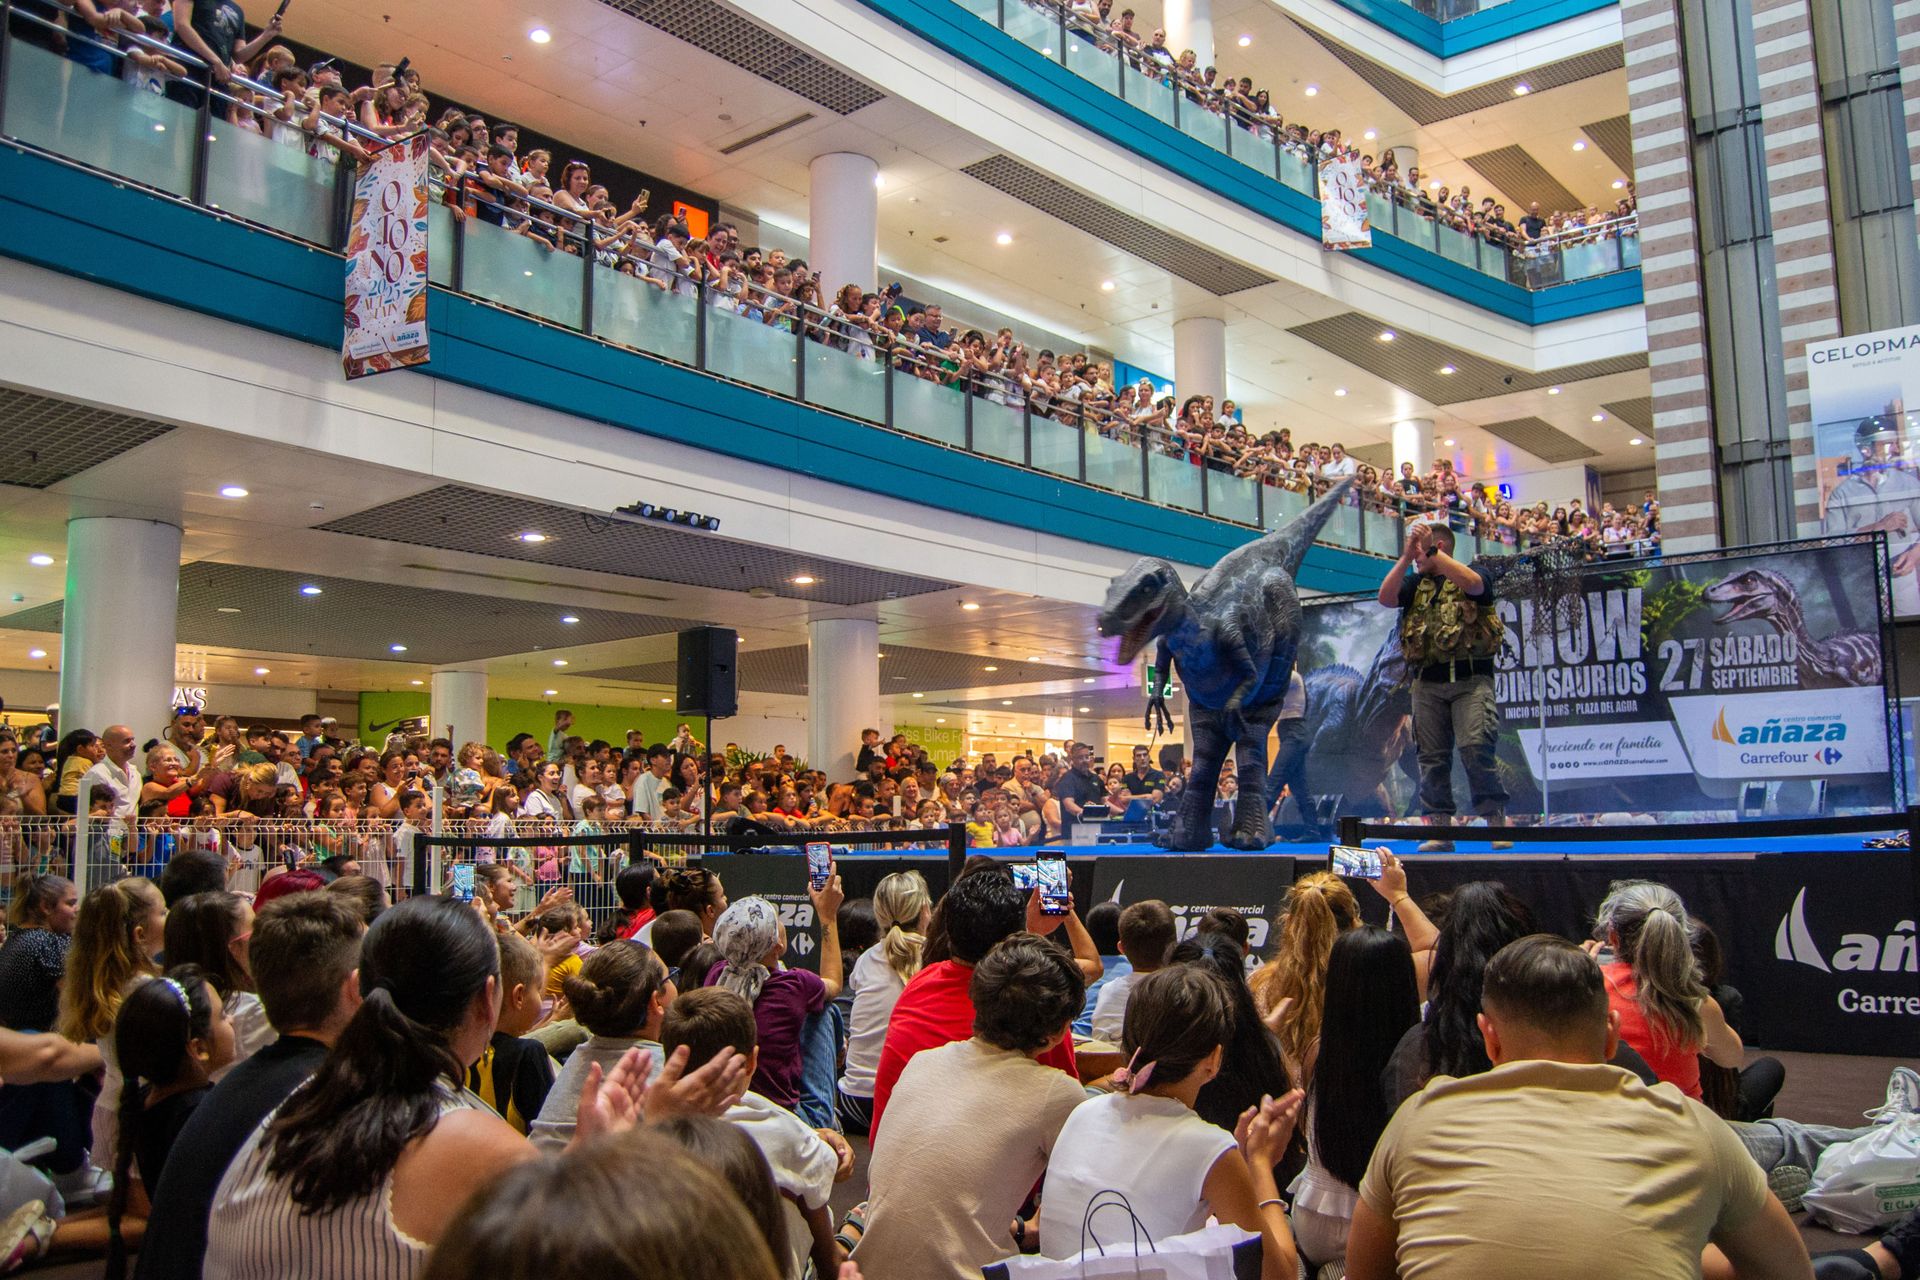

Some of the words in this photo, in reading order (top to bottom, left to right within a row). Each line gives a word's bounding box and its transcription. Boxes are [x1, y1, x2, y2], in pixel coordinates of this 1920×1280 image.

[368, 279, 401, 304] 2025
[396, 331, 420, 342] añaza
[1494, 587, 1642, 671] SHOW
[1709, 631, 1798, 668] SÁBADO
[1657, 638, 1705, 693] 27
[1711, 664, 1798, 690] SEPTIEMBRE
[1493, 660, 1647, 704] DINOSAURIOS
[1505, 706, 1529, 719] INICIO
[1553, 703, 1569, 716] HRS
[1576, 702, 1599, 715] PLAZA
[1600, 701, 1613, 713] DEL
[1616, 700, 1638, 713] AGUA
[1807, 713, 1842, 721] comercial
[924, 728, 950, 744] Bike
[1737, 718, 1846, 745] añaza
[1599, 741, 1613, 751] en
[1615, 735, 1662, 758] familia
[1740, 751, 1808, 764] Carrefour
